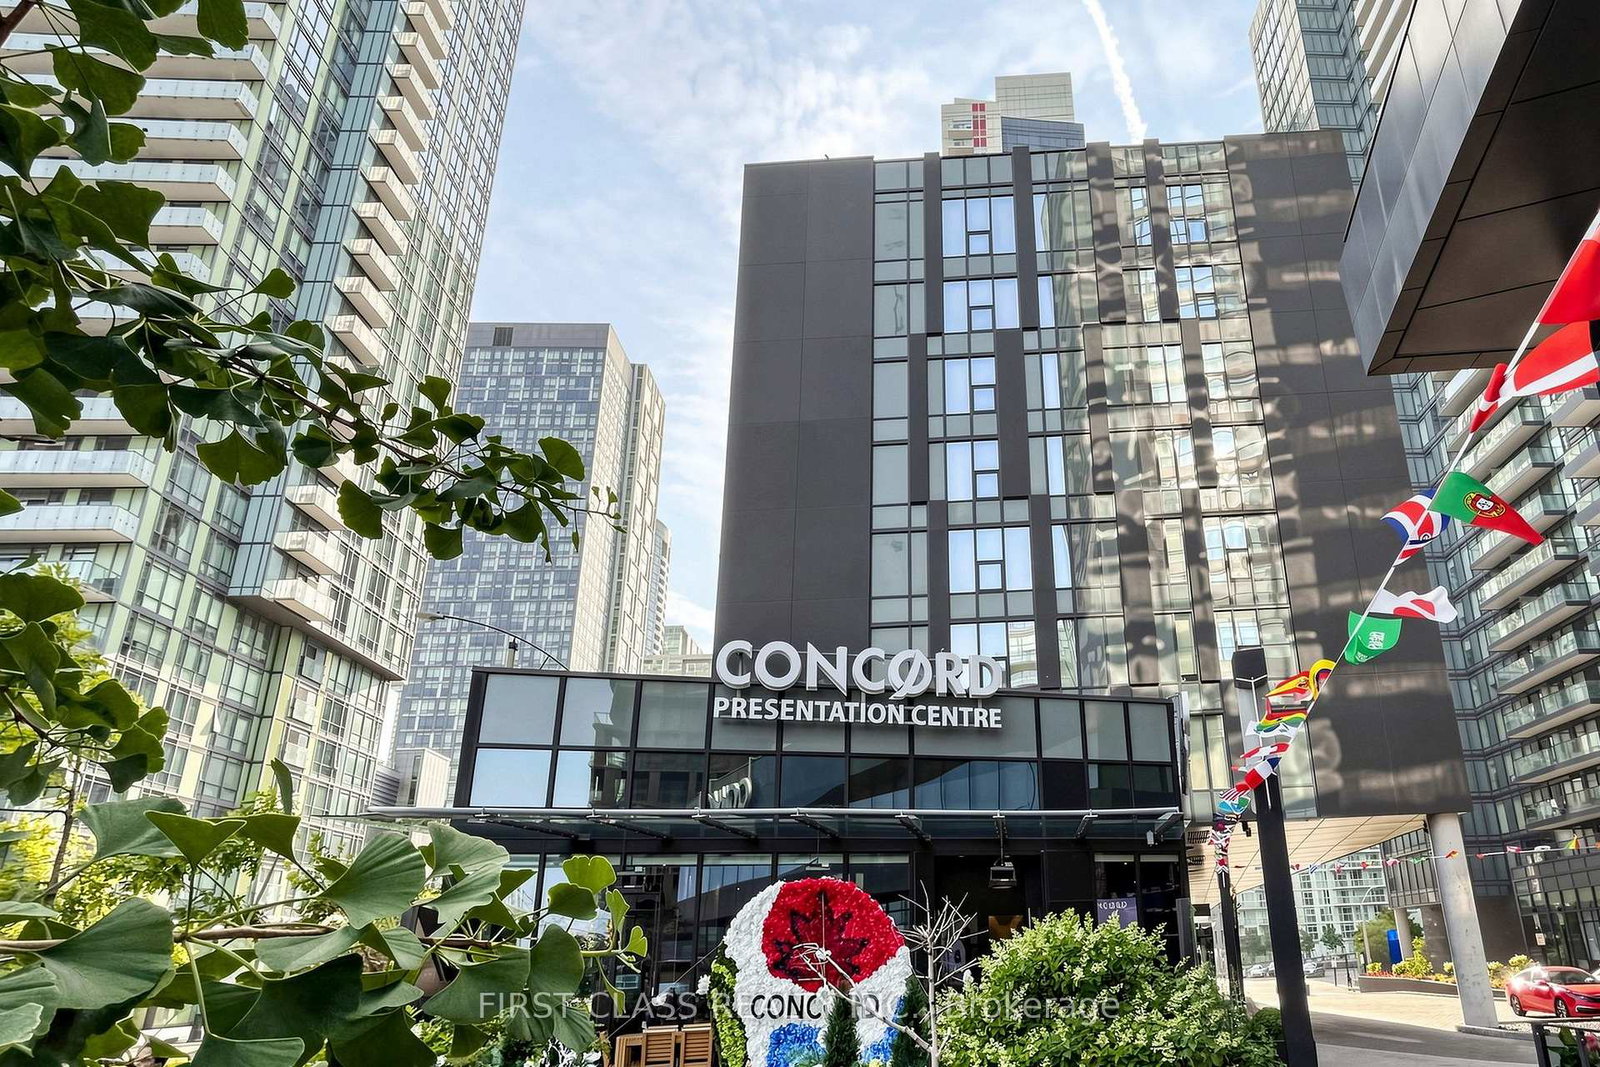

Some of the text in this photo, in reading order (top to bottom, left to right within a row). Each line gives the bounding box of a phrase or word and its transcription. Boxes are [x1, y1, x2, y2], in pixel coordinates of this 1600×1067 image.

[713, 696, 1003, 728] PRESENTATION CENTRE
[751, 994, 880, 1020] CONCRD
